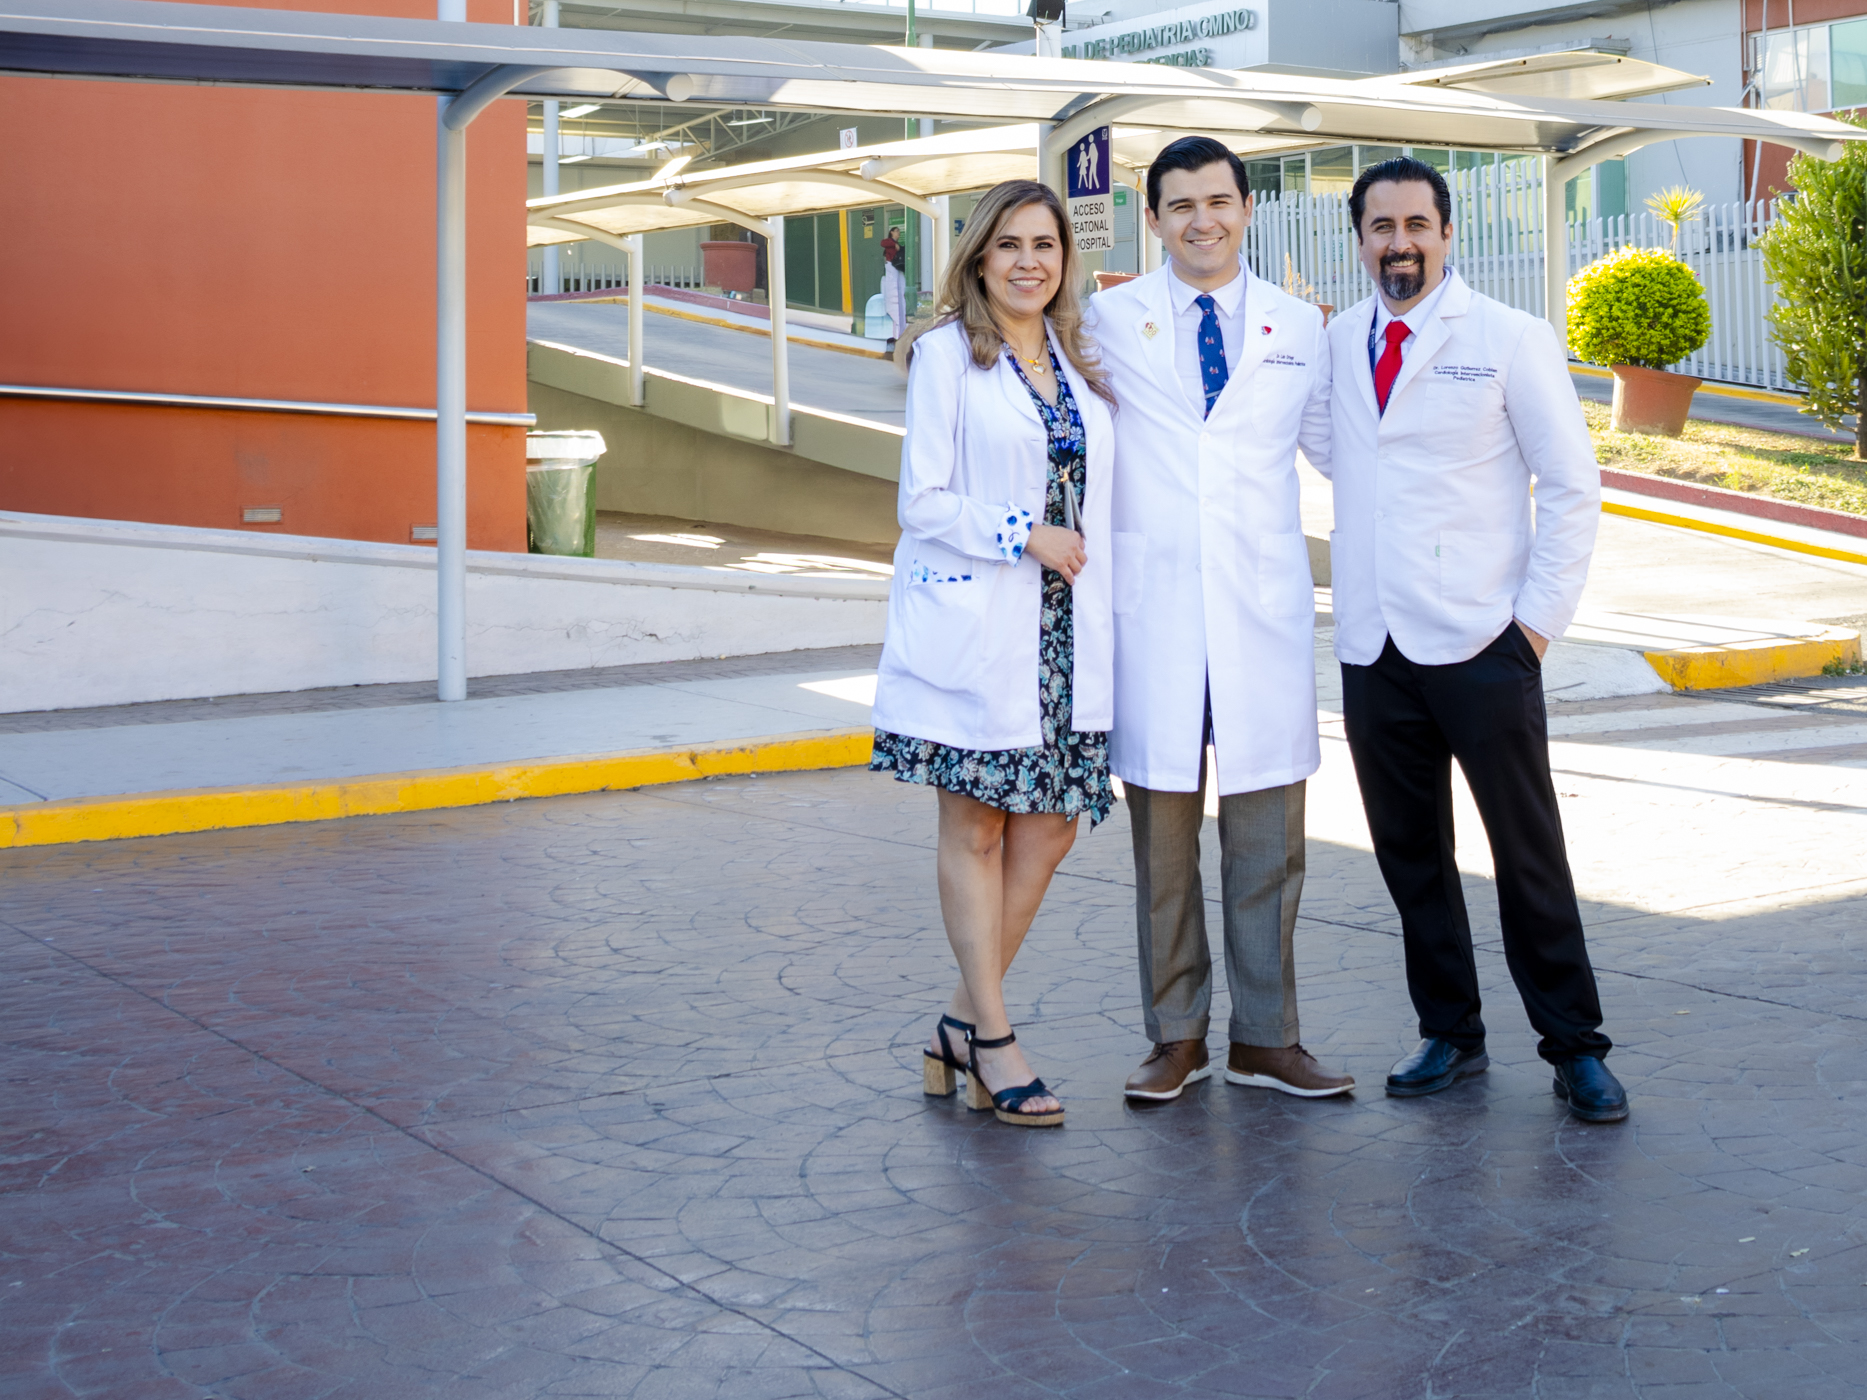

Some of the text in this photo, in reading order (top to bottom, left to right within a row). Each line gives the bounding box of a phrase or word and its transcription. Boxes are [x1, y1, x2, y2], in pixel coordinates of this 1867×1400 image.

[1083, 38, 1106, 60] DE
[1109, 19, 1193, 56] PEDIATRIA
[1197, 8, 1250, 38] CMNO
[1073, 202, 1105, 217] ACCESO
